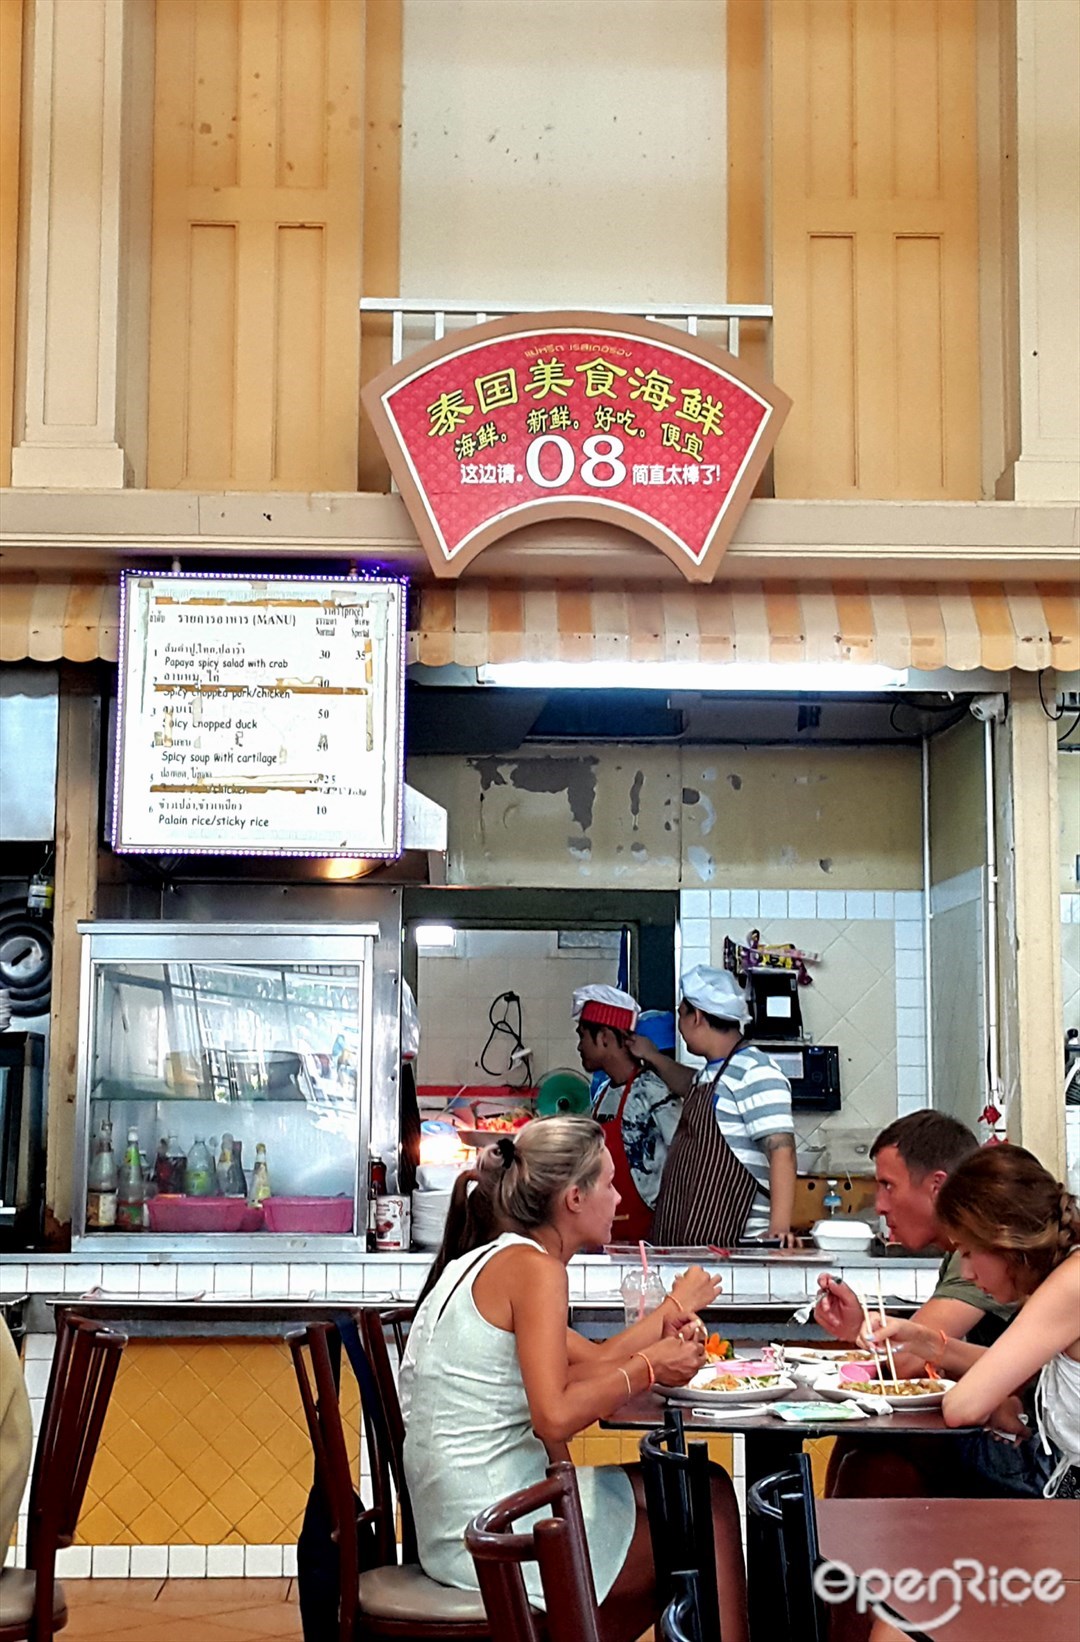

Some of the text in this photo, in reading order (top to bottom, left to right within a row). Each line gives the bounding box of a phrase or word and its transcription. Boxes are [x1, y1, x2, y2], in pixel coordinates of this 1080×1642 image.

[426, 356, 724, 437] 泰国美食海鲜
[660, 422, 704, 462] 便宜
[525, 434, 627, 488] 08
[252, 613, 296, 627] (MANU)
[319, 649, 331, 660] 30
[164, 656, 289, 670] Papaya spicy salad with crab
[317, 708, 330, 719] 50
[163, 718, 189, 731] picy
[235, 718, 258, 729] duck
[161, 750, 187, 765] Spicy
[190, 753, 211, 766] soup
[236, 751, 278, 767] cartilage
[316, 805, 328, 816] 10
[158, 814, 269, 829] Palain rice/sticky rice
